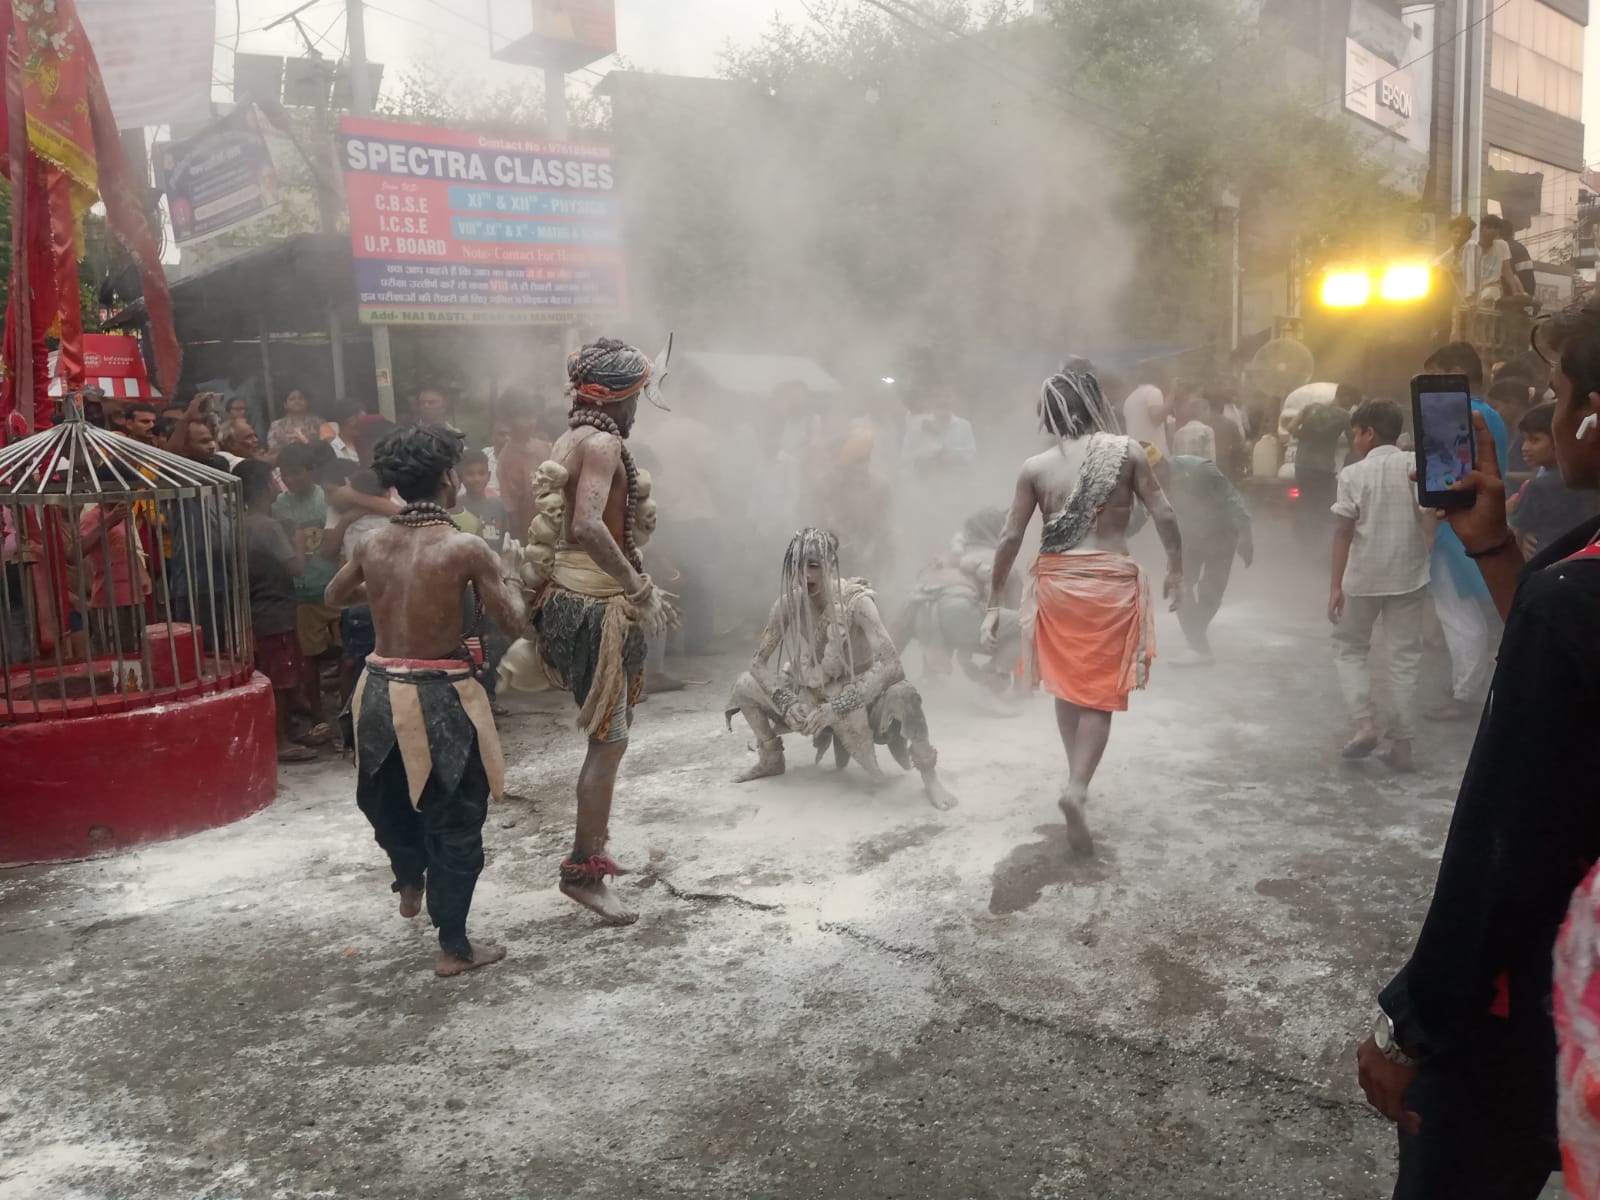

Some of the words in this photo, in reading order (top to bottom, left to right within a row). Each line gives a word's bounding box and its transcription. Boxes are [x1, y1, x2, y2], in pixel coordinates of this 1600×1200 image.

[1382, 79, 1412, 117] EPSON
[346, 139, 488, 180] SPECTRA
[494, 155, 614, 190] CLASSES
[375, 193, 429, 213] C.B.S.E
[496, 194, 507, 210] &
[551, 198, 609, 215] PHYSICS
[379, 215, 429, 234] I.C.S.E
[364, 235, 393, 253] U.P.
[396, 237, 447, 256] BOARD
